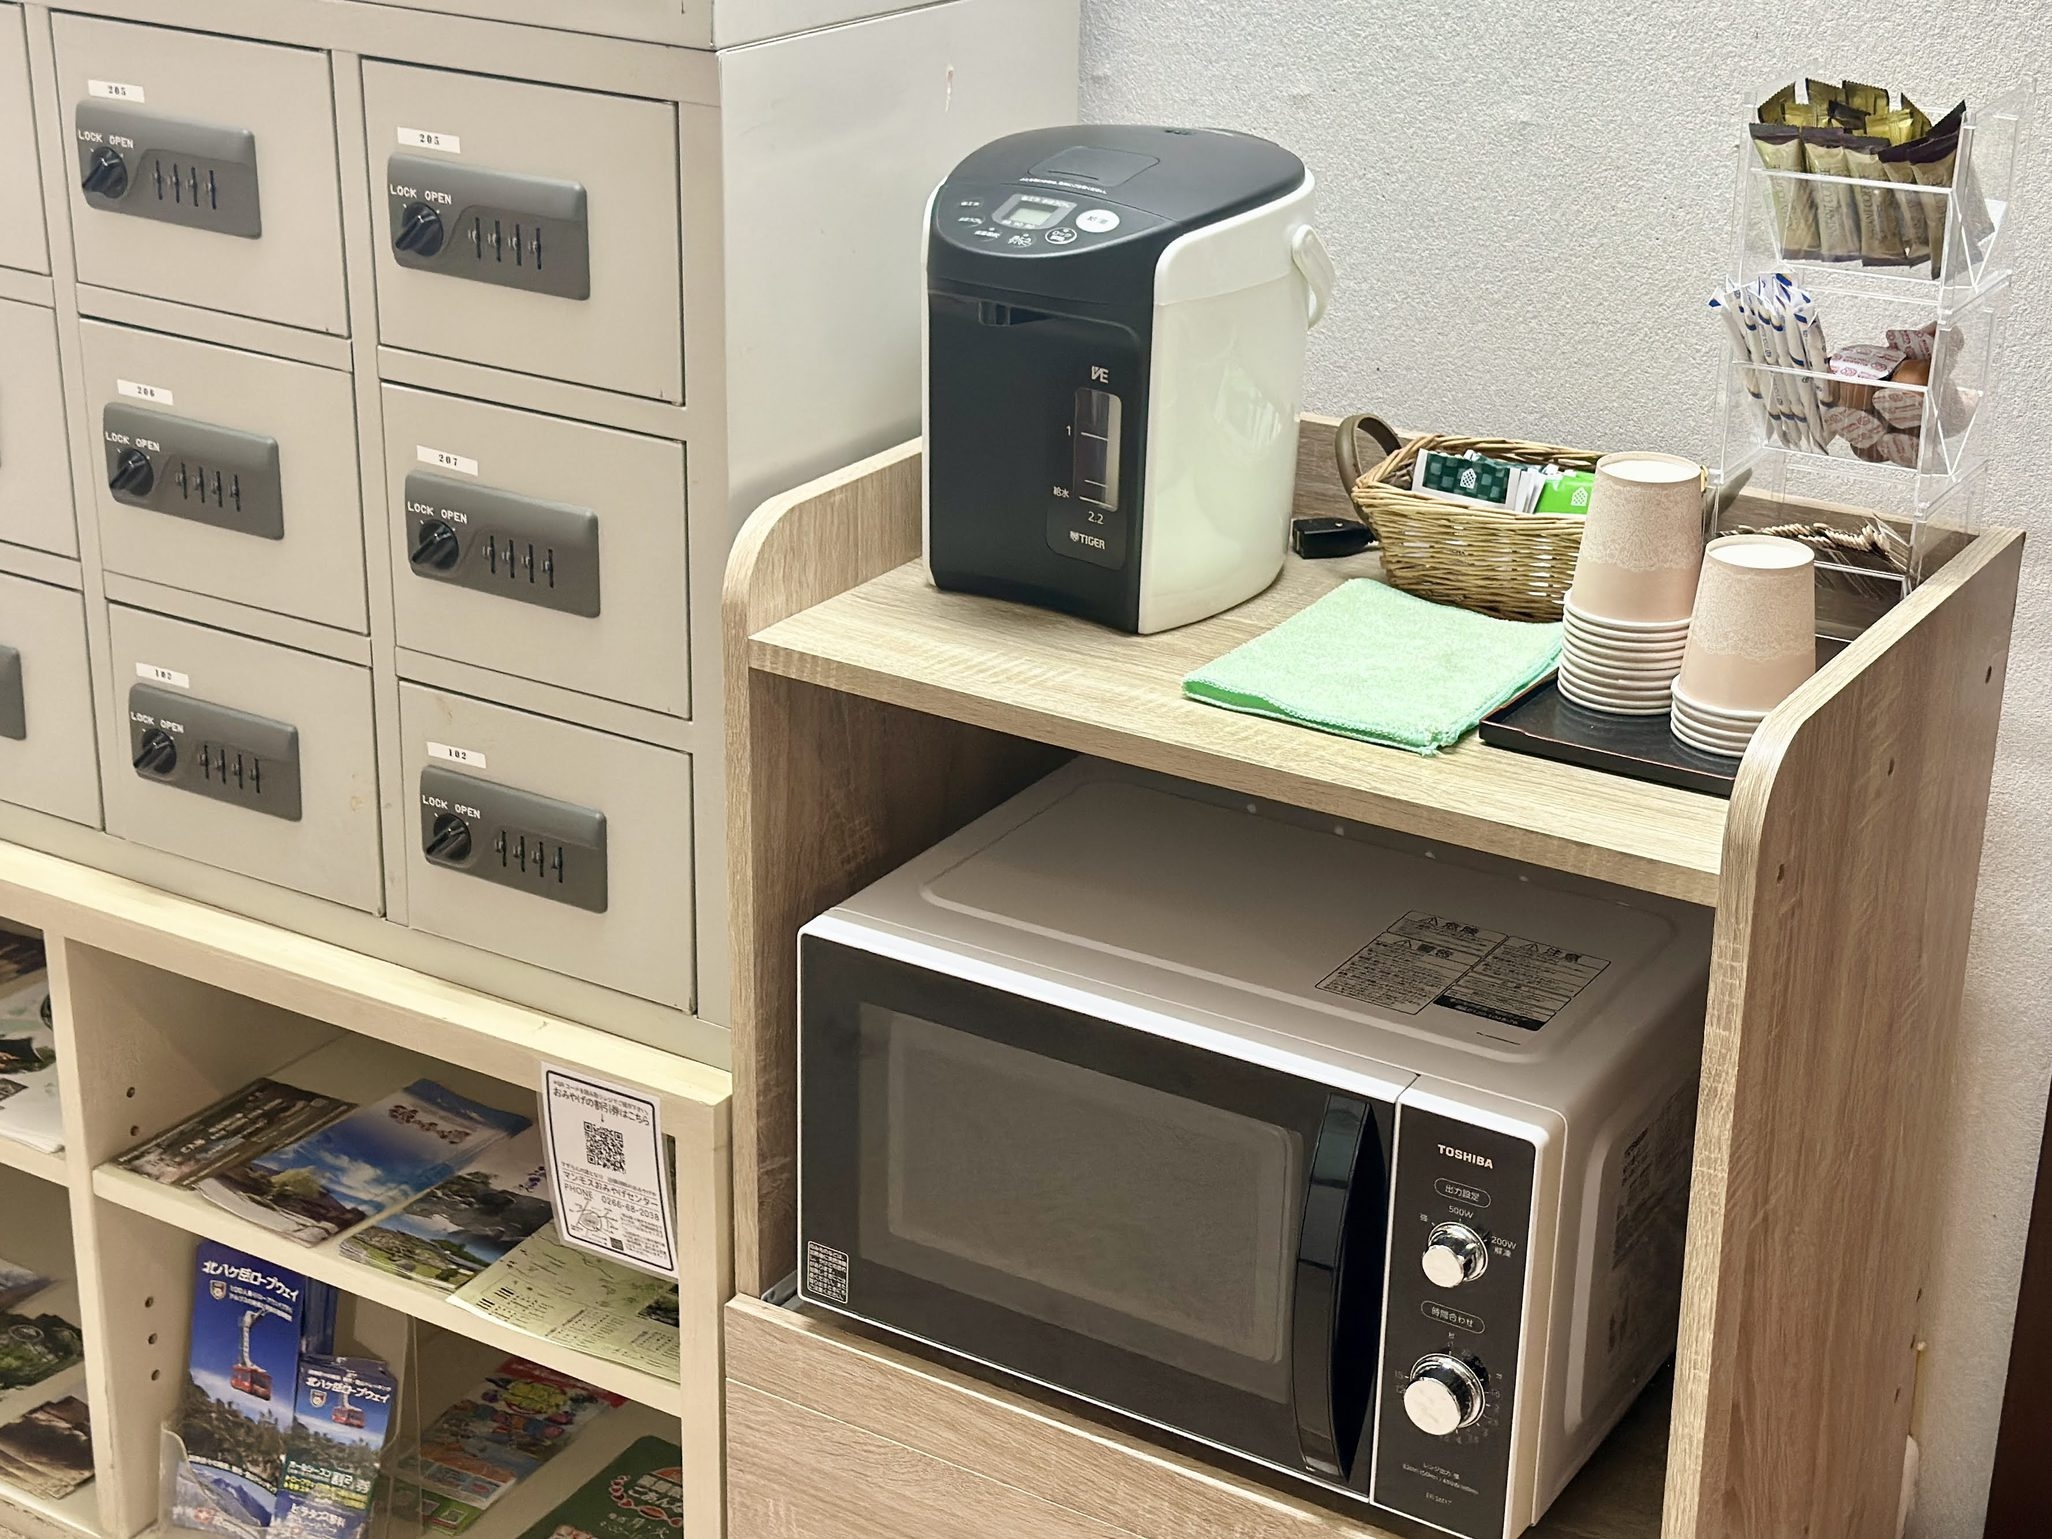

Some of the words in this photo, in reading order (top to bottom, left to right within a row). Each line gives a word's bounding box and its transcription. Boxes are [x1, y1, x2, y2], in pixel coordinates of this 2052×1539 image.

[108, 84, 126, 96] 205
[78, 129, 103, 143] LOCK
[109, 135, 134, 148] OPEN
[419, 134, 440, 146] 205
[390, 184, 417, 198] LOCK
[424, 190, 452, 205] OPEN
[1066, 425, 1071, 436] 1
[105, 431, 130, 445] LOCK
[135, 438, 160, 452] OPEN
[438, 454, 458, 466] 207
[407, 501, 434, 516] LOCK
[441, 509, 467, 525] OPEN
[1088, 510, 1104, 525] 2.2
[1079, 533, 1106, 550] TIGER
[130, 711, 155, 725] LOCK
[160, 719, 184, 734] OPEN
[448, 748, 467, 760] 102
[422, 795, 448, 810] LOCK
[454, 803, 480, 819] OPEN
[1438, 1144, 1493, 1169] TOSHIBA
[564, 1183, 593, 1199] PHONE
[1448, 1205, 1474, 1219] 500W
[1491, 1235, 1517, 1250] 200W
